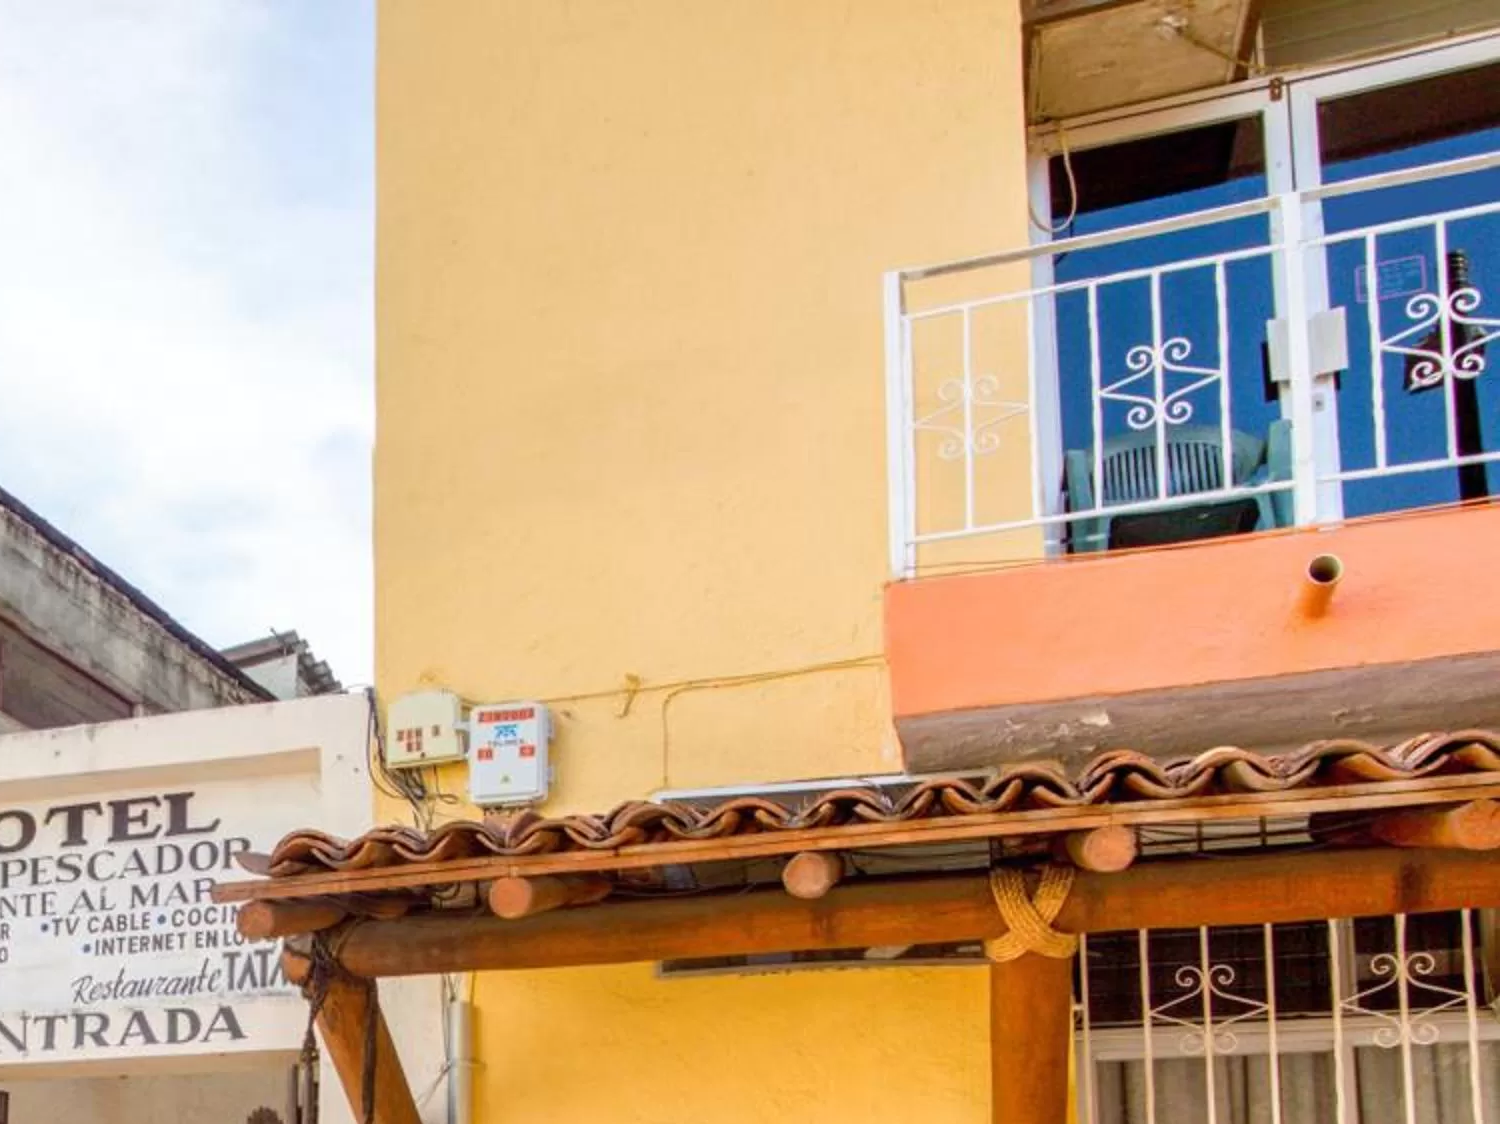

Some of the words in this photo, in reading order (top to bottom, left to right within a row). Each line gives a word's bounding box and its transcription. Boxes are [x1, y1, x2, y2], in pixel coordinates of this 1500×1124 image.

[0, 837, 251, 889] PESCADOR
[68, 887, 116, 915] AL
[131, 878, 216, 910] MAR
[51, 917, 80, 937] TV
[87, 911, 151, 934] CABLE
[94, 931, 187, 956] INTERNET
[195, 930, 219, 949] EN
[70, 958, 222, 1004] Restaurante
